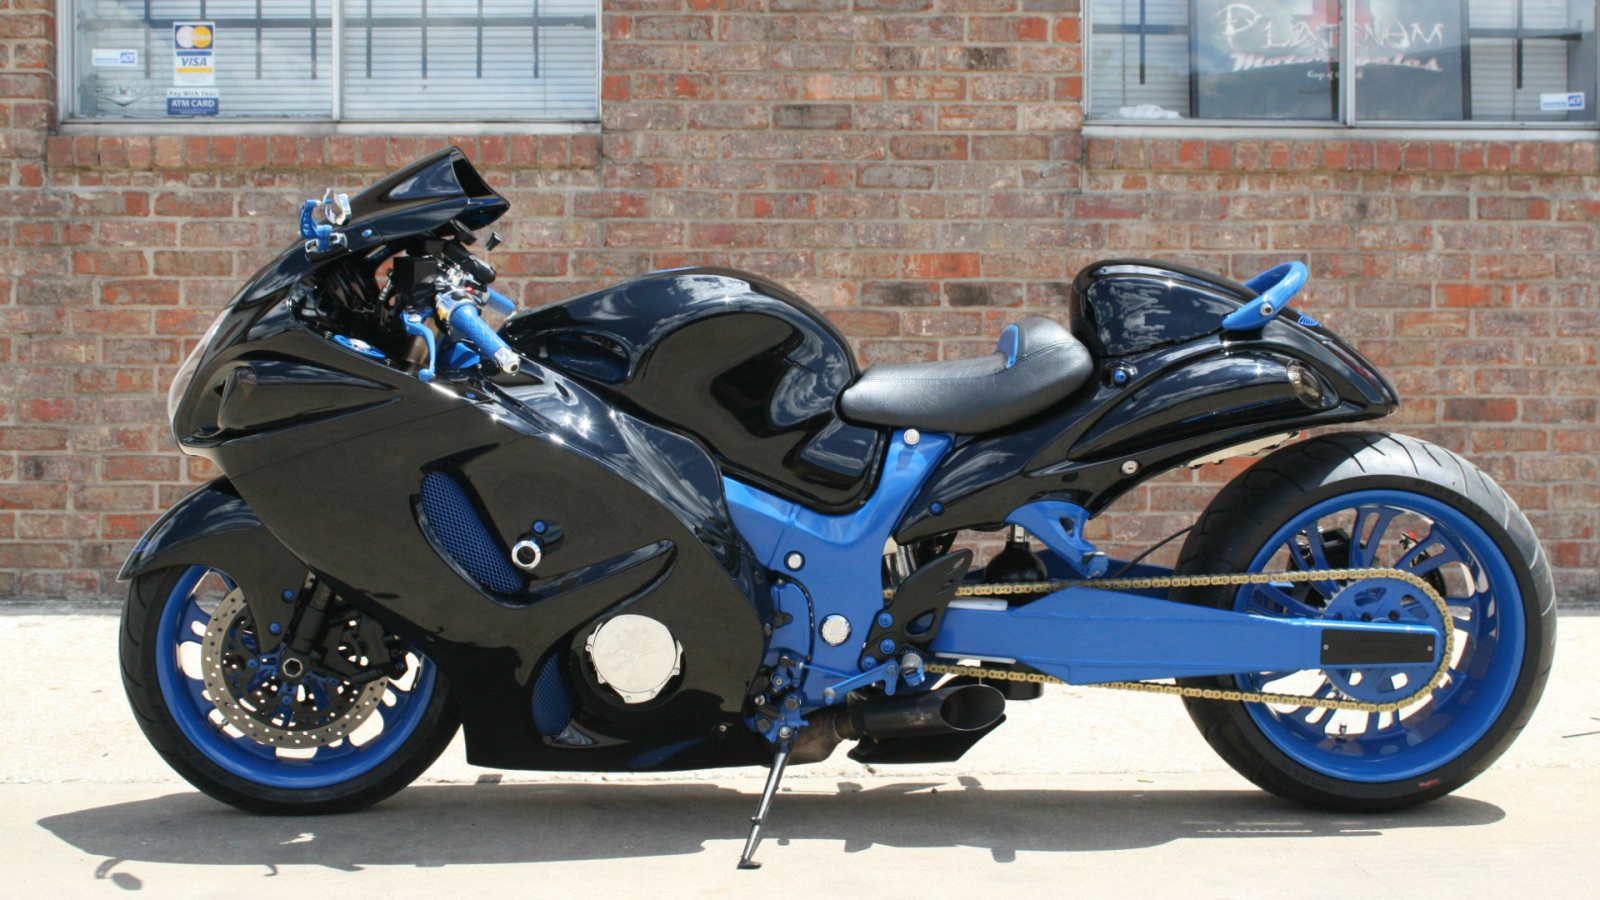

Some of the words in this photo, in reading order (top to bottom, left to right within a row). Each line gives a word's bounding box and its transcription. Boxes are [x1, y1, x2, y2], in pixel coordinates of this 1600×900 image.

[1216, 4, 1443, 49] PLATNUM
[181, 57, 207, 66] VISA
[171, 99, 190, 107] ATM
[191, 99, 215, 107] CARD
